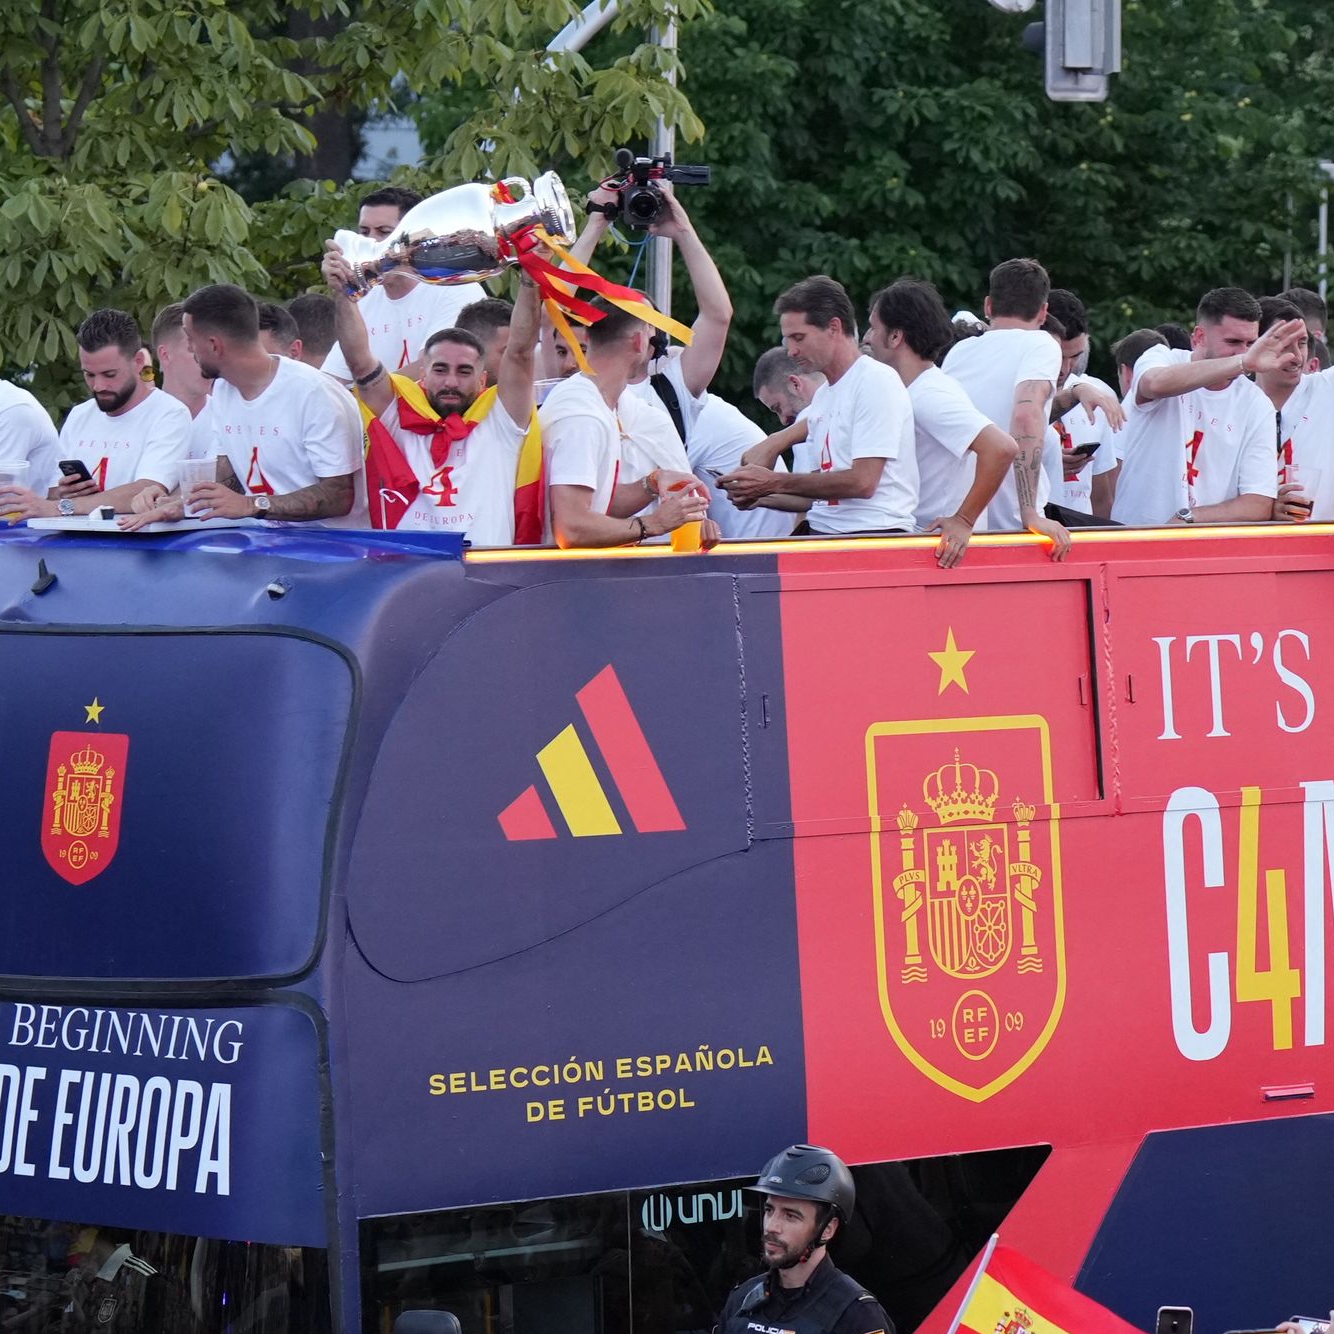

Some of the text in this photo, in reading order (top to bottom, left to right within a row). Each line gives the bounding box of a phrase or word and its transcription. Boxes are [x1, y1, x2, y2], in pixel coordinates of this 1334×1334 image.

[422, 465, 459, 507] 4
[898, 871, 921, 885] PLVS
[1011, 864, 1039, 878] VLTRA
[8, 1002, 245, 1064] BEGINNING
[428, 1043, 774, 1097] SELECCIÓN ESPAÑOLA
[525, 1087, 695, 1123] DE FÚTBOL
[48, 1067, 232, 1196] EUROPA
